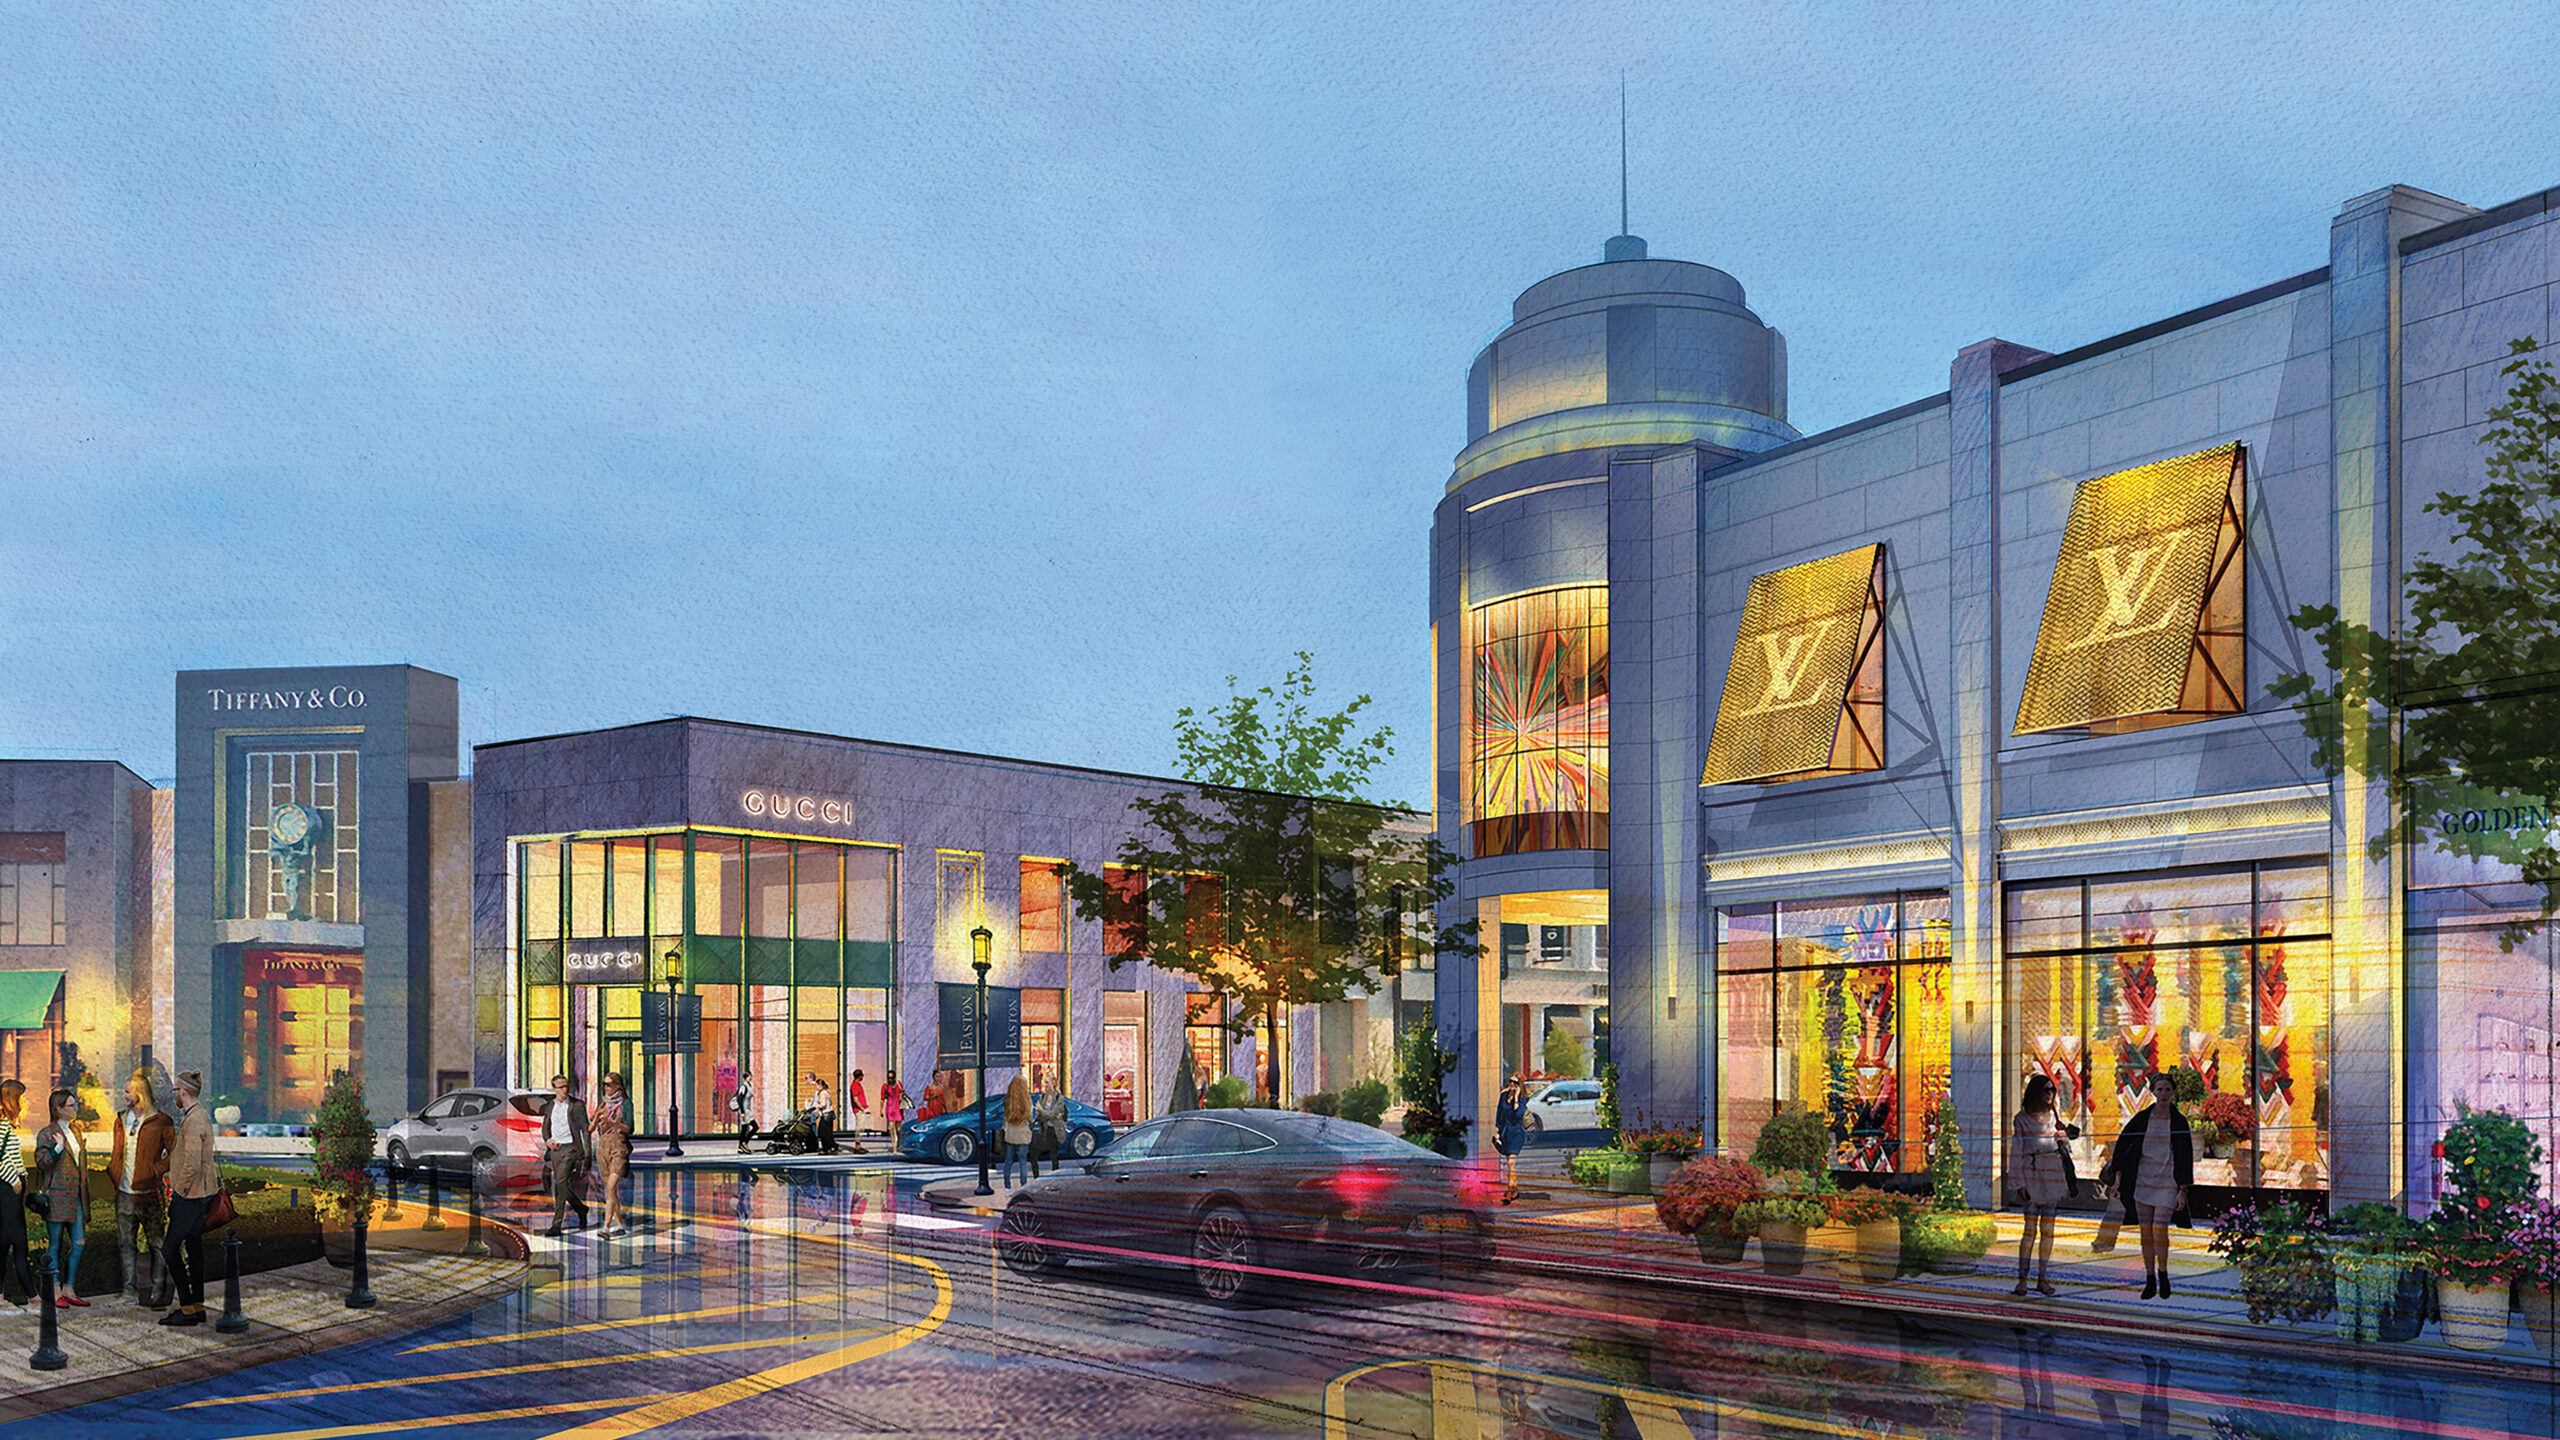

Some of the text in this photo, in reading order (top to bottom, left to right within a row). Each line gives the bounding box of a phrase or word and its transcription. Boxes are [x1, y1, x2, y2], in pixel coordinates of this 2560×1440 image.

[743, 790, 853, 825] GUCCI
[2442, 803, 2549, 835] GOLDEN
[567, 951, 642, 969] GUCCI
